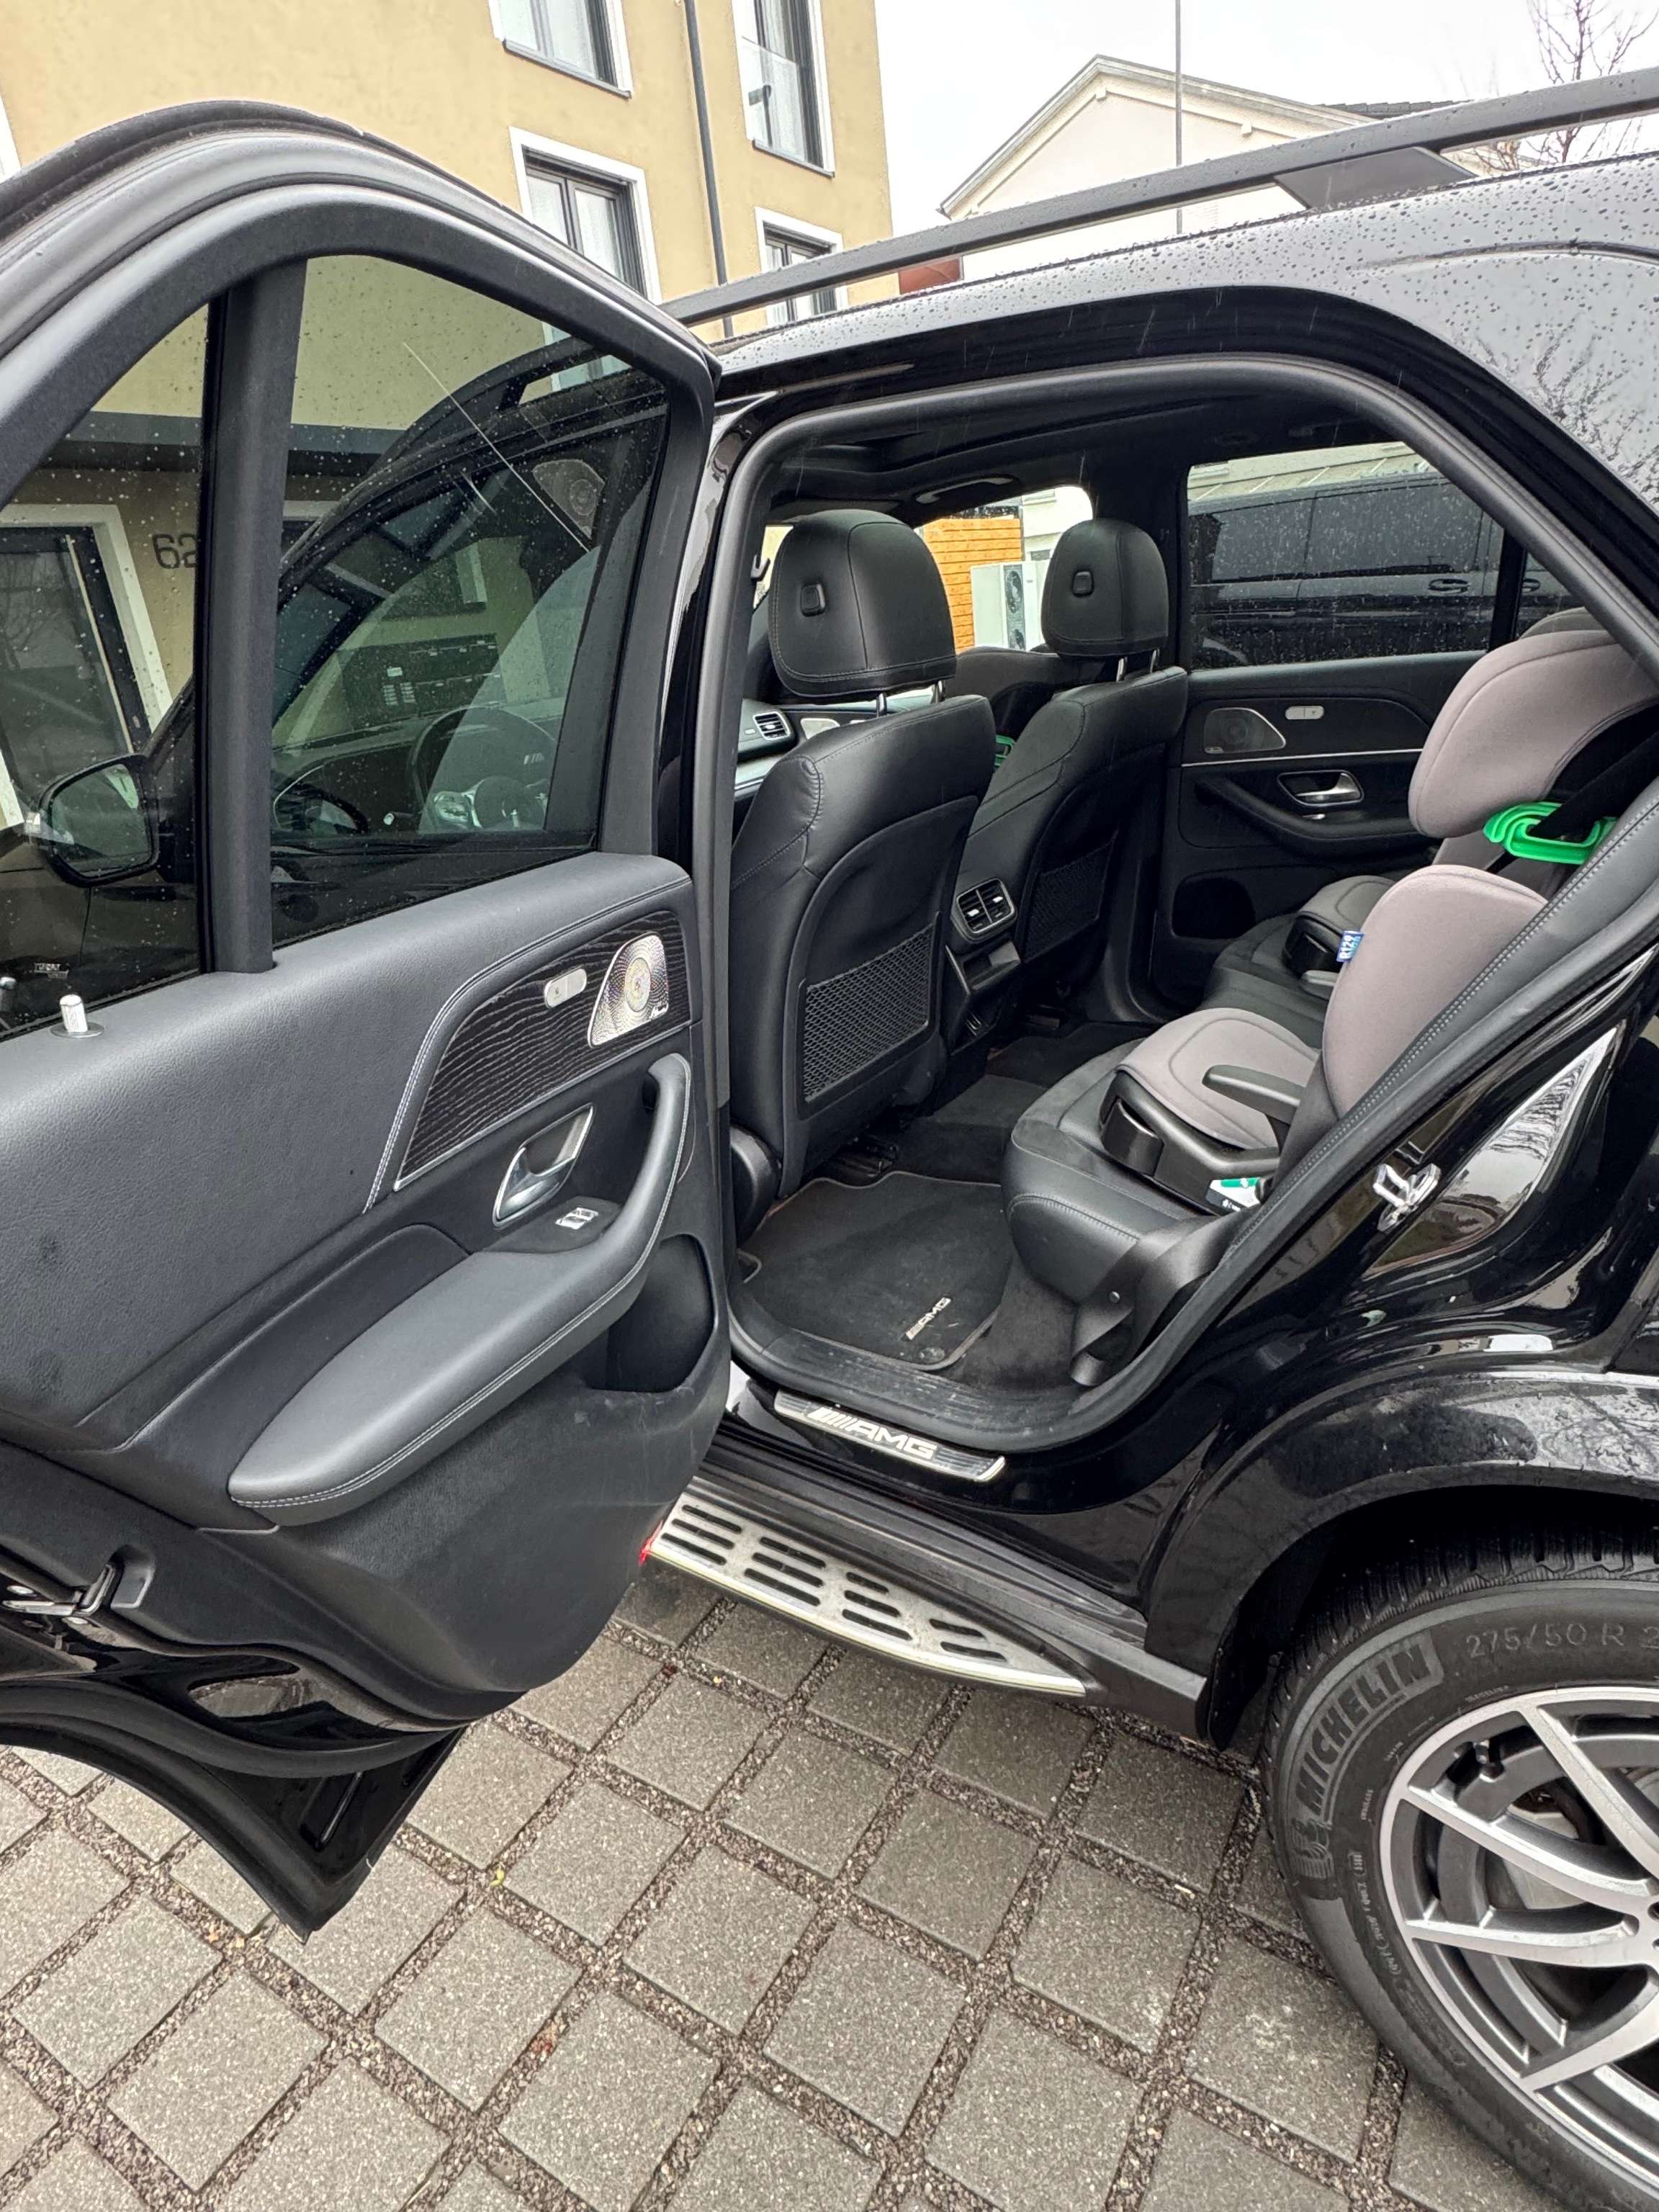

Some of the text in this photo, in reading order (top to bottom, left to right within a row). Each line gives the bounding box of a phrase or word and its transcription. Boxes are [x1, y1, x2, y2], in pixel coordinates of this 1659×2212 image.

[1466, 1622, 1588, 1659] 275/50
[1601, 1622, 1624, 1647] R
[1298, 1643, 1432, 1817] MICHELIN
